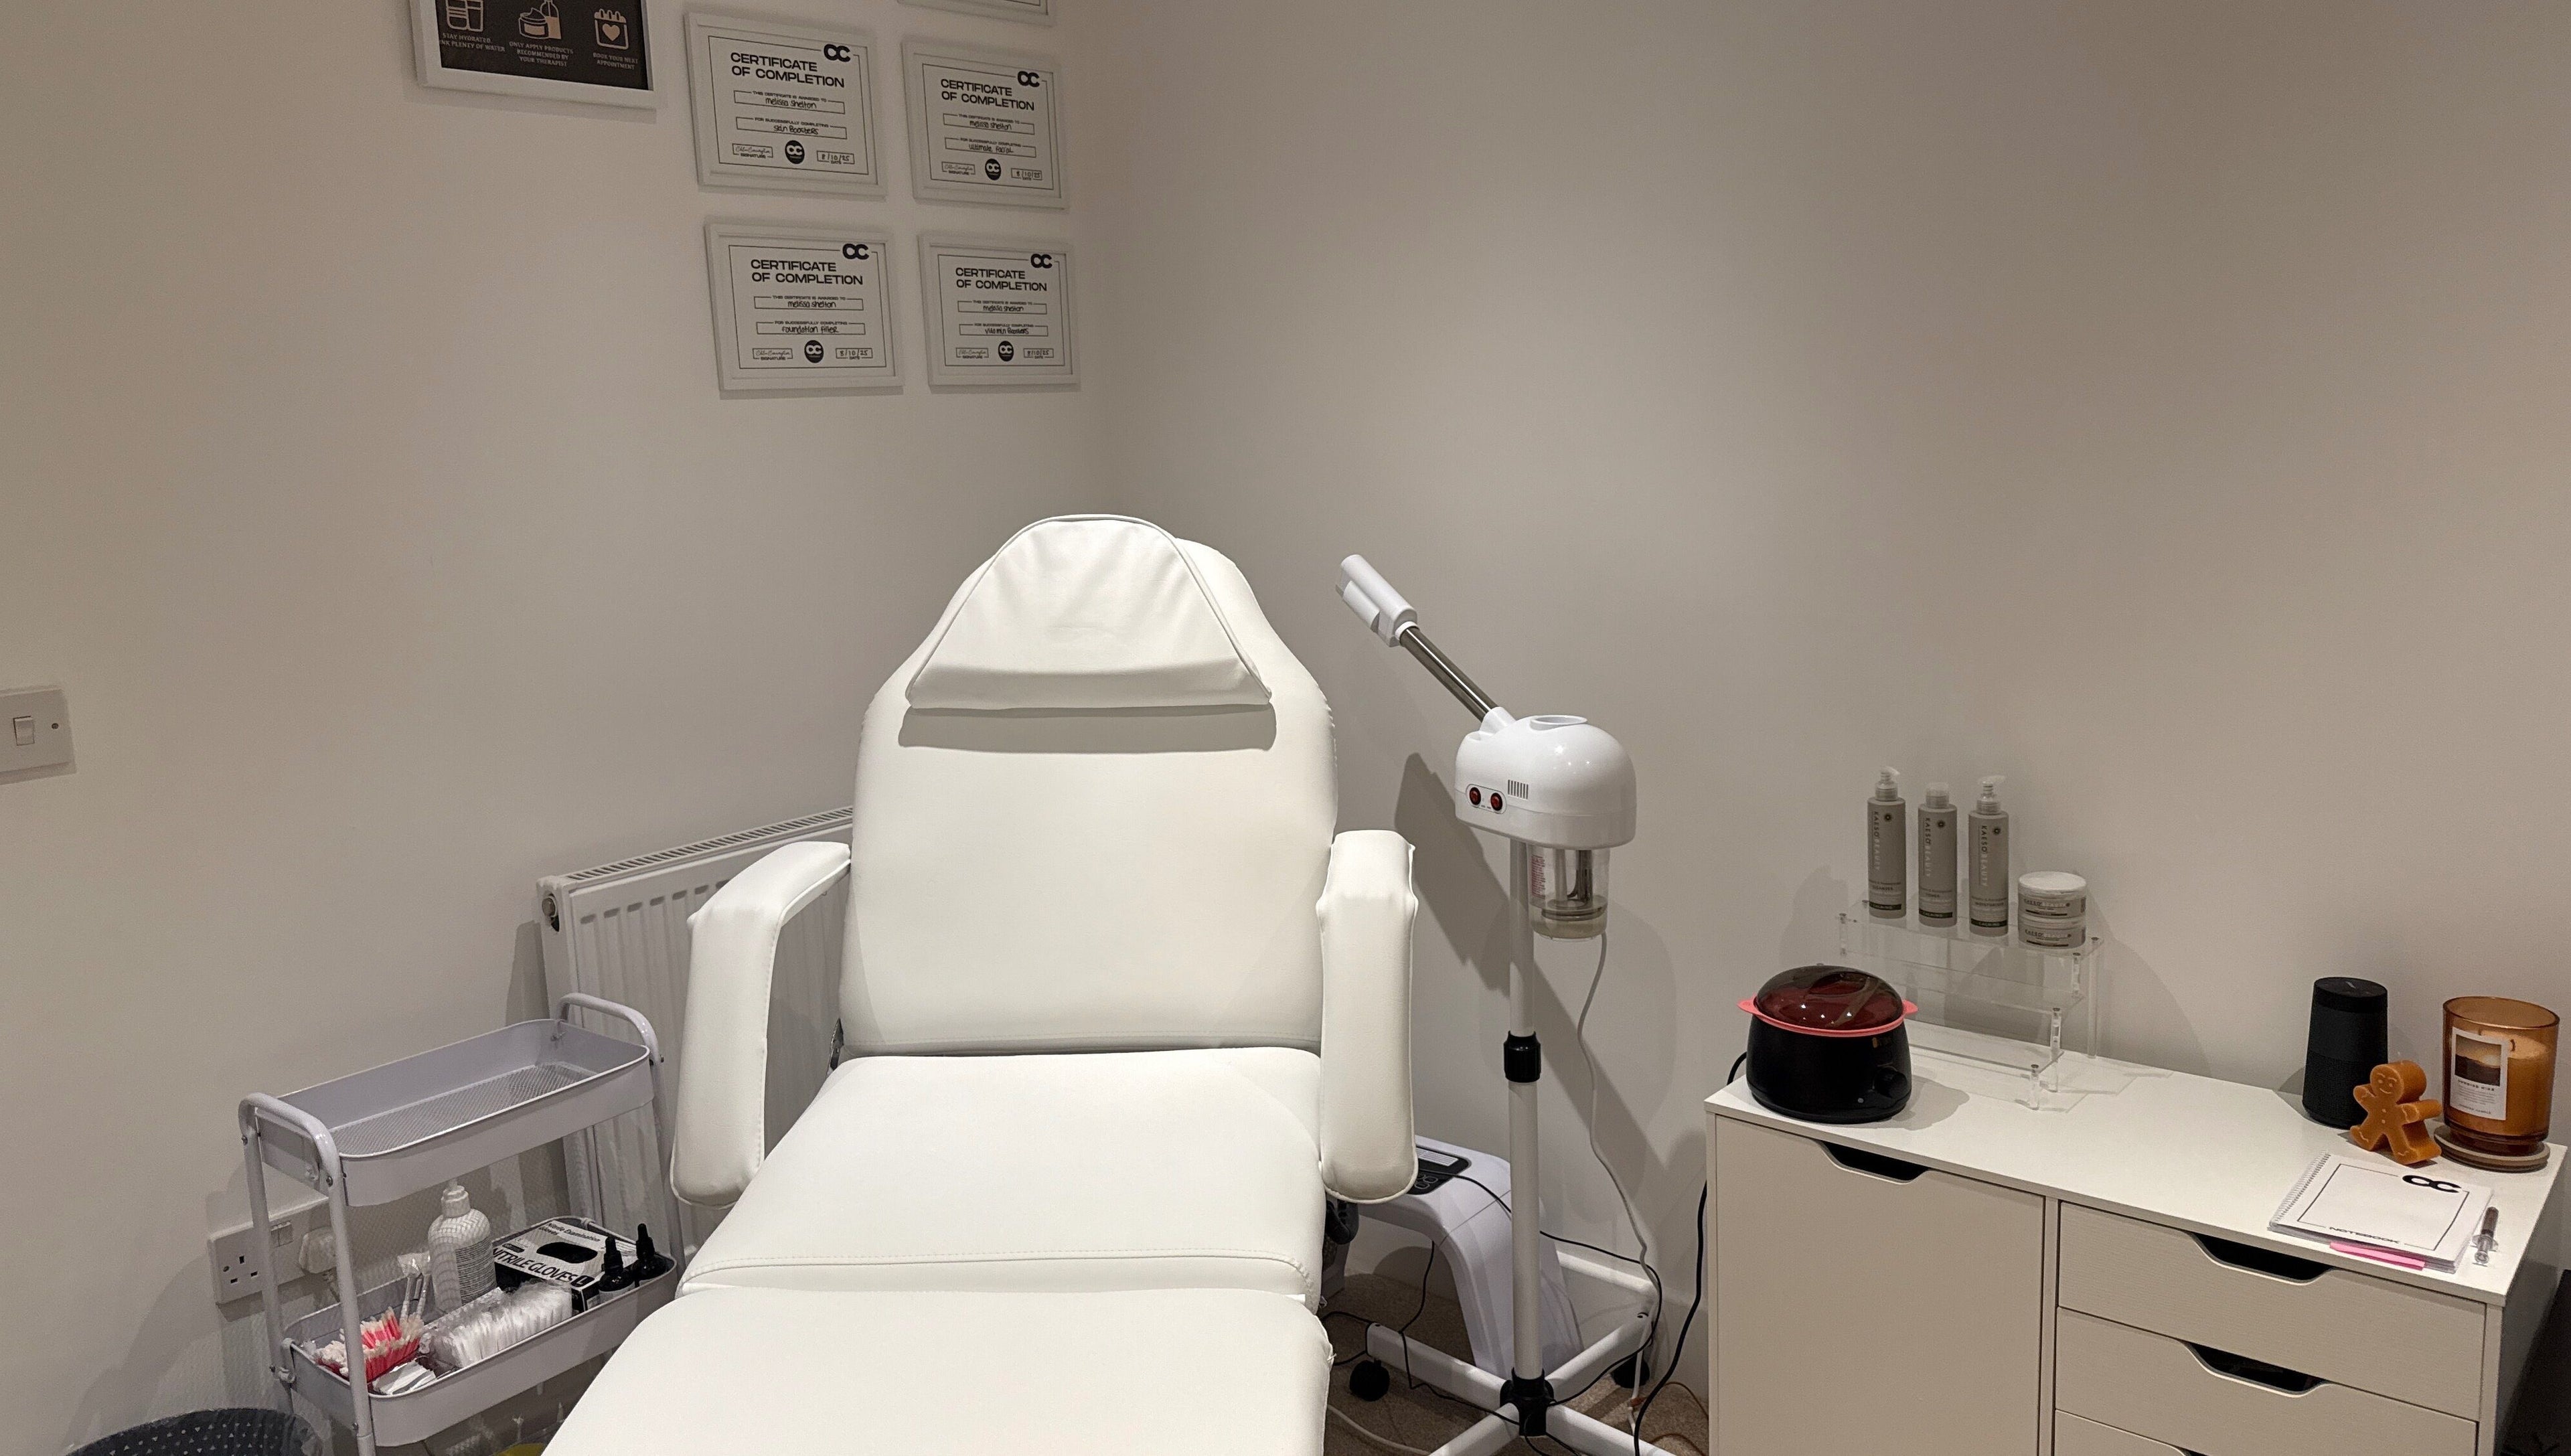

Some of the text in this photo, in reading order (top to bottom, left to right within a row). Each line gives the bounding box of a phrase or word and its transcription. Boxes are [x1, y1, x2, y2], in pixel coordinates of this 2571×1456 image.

[451, 40, 475, 48] PLENTY
[459, 35, 491, 43] HYDRATED
[517, 48, 560, 59] RECOMMENDED
[544, 45, 574, 54] PRODUCTS
[536, 58, 568, 67] THERAPIST
[597, 59, 635, 70] APPOINTMENT
[730, 52, 817, 72] CERTIFICATE
[731, 66, 844, 88] OF COMPLETION
[941, 78, 1012, 96] CERTIFICATE
[941, 90, 1034, 111] OF COMPLETION
[751, 259, 837, 272] CERTIFICATE
[752, 272, 863, 285] OF COMPLETION
[955, 267, 1025, 279] CERTIFICATE
[956, 279, 1047, 291] OF COMPLETION
[564, 1229, 601, 1242] Examination
[2329, 1226, 2400, 1244] NOTEBOOK
[493, 1248, 535, 1269] NITRILE
[528, 1262, 578, 1283] GLOVES
